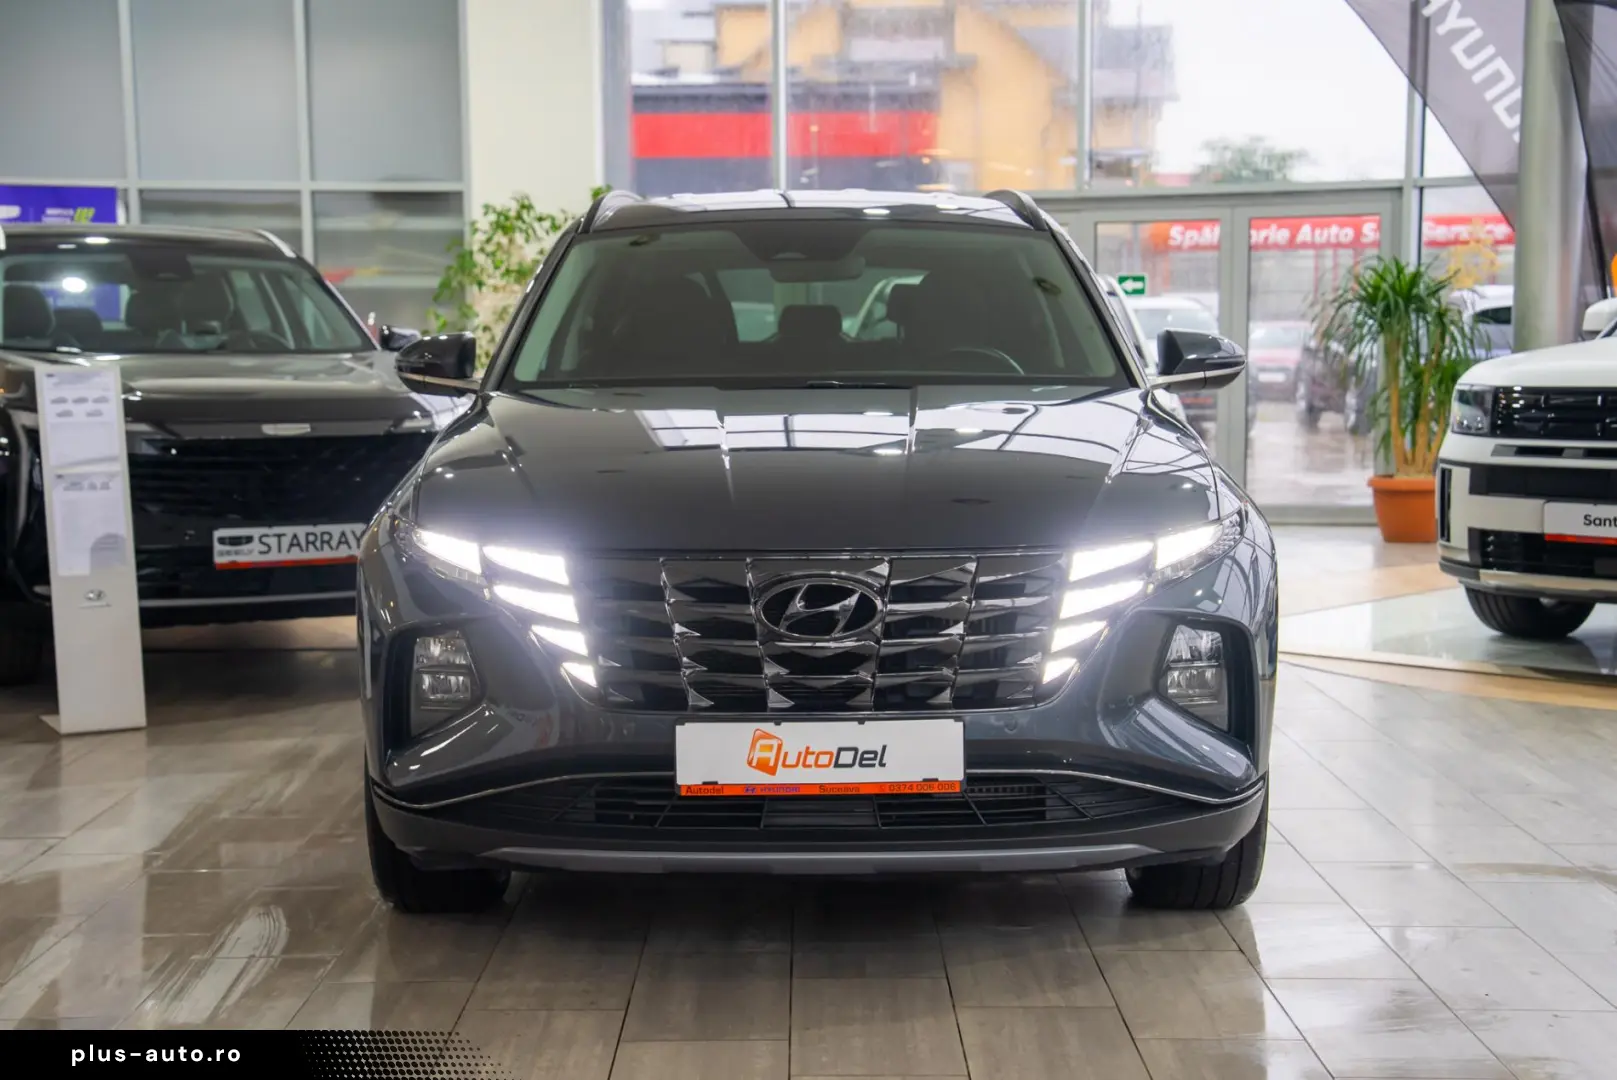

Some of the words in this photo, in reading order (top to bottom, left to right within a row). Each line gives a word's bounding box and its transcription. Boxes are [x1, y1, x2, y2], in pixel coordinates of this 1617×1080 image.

[1296, 223, 1354, 246] Auto
[258, 531, 365, 555] STARRAY
[750, 735, 887, 770] AutoDel
[685, 786, 724, 795] Autodel
[888, 784, 913, 792] 0374
